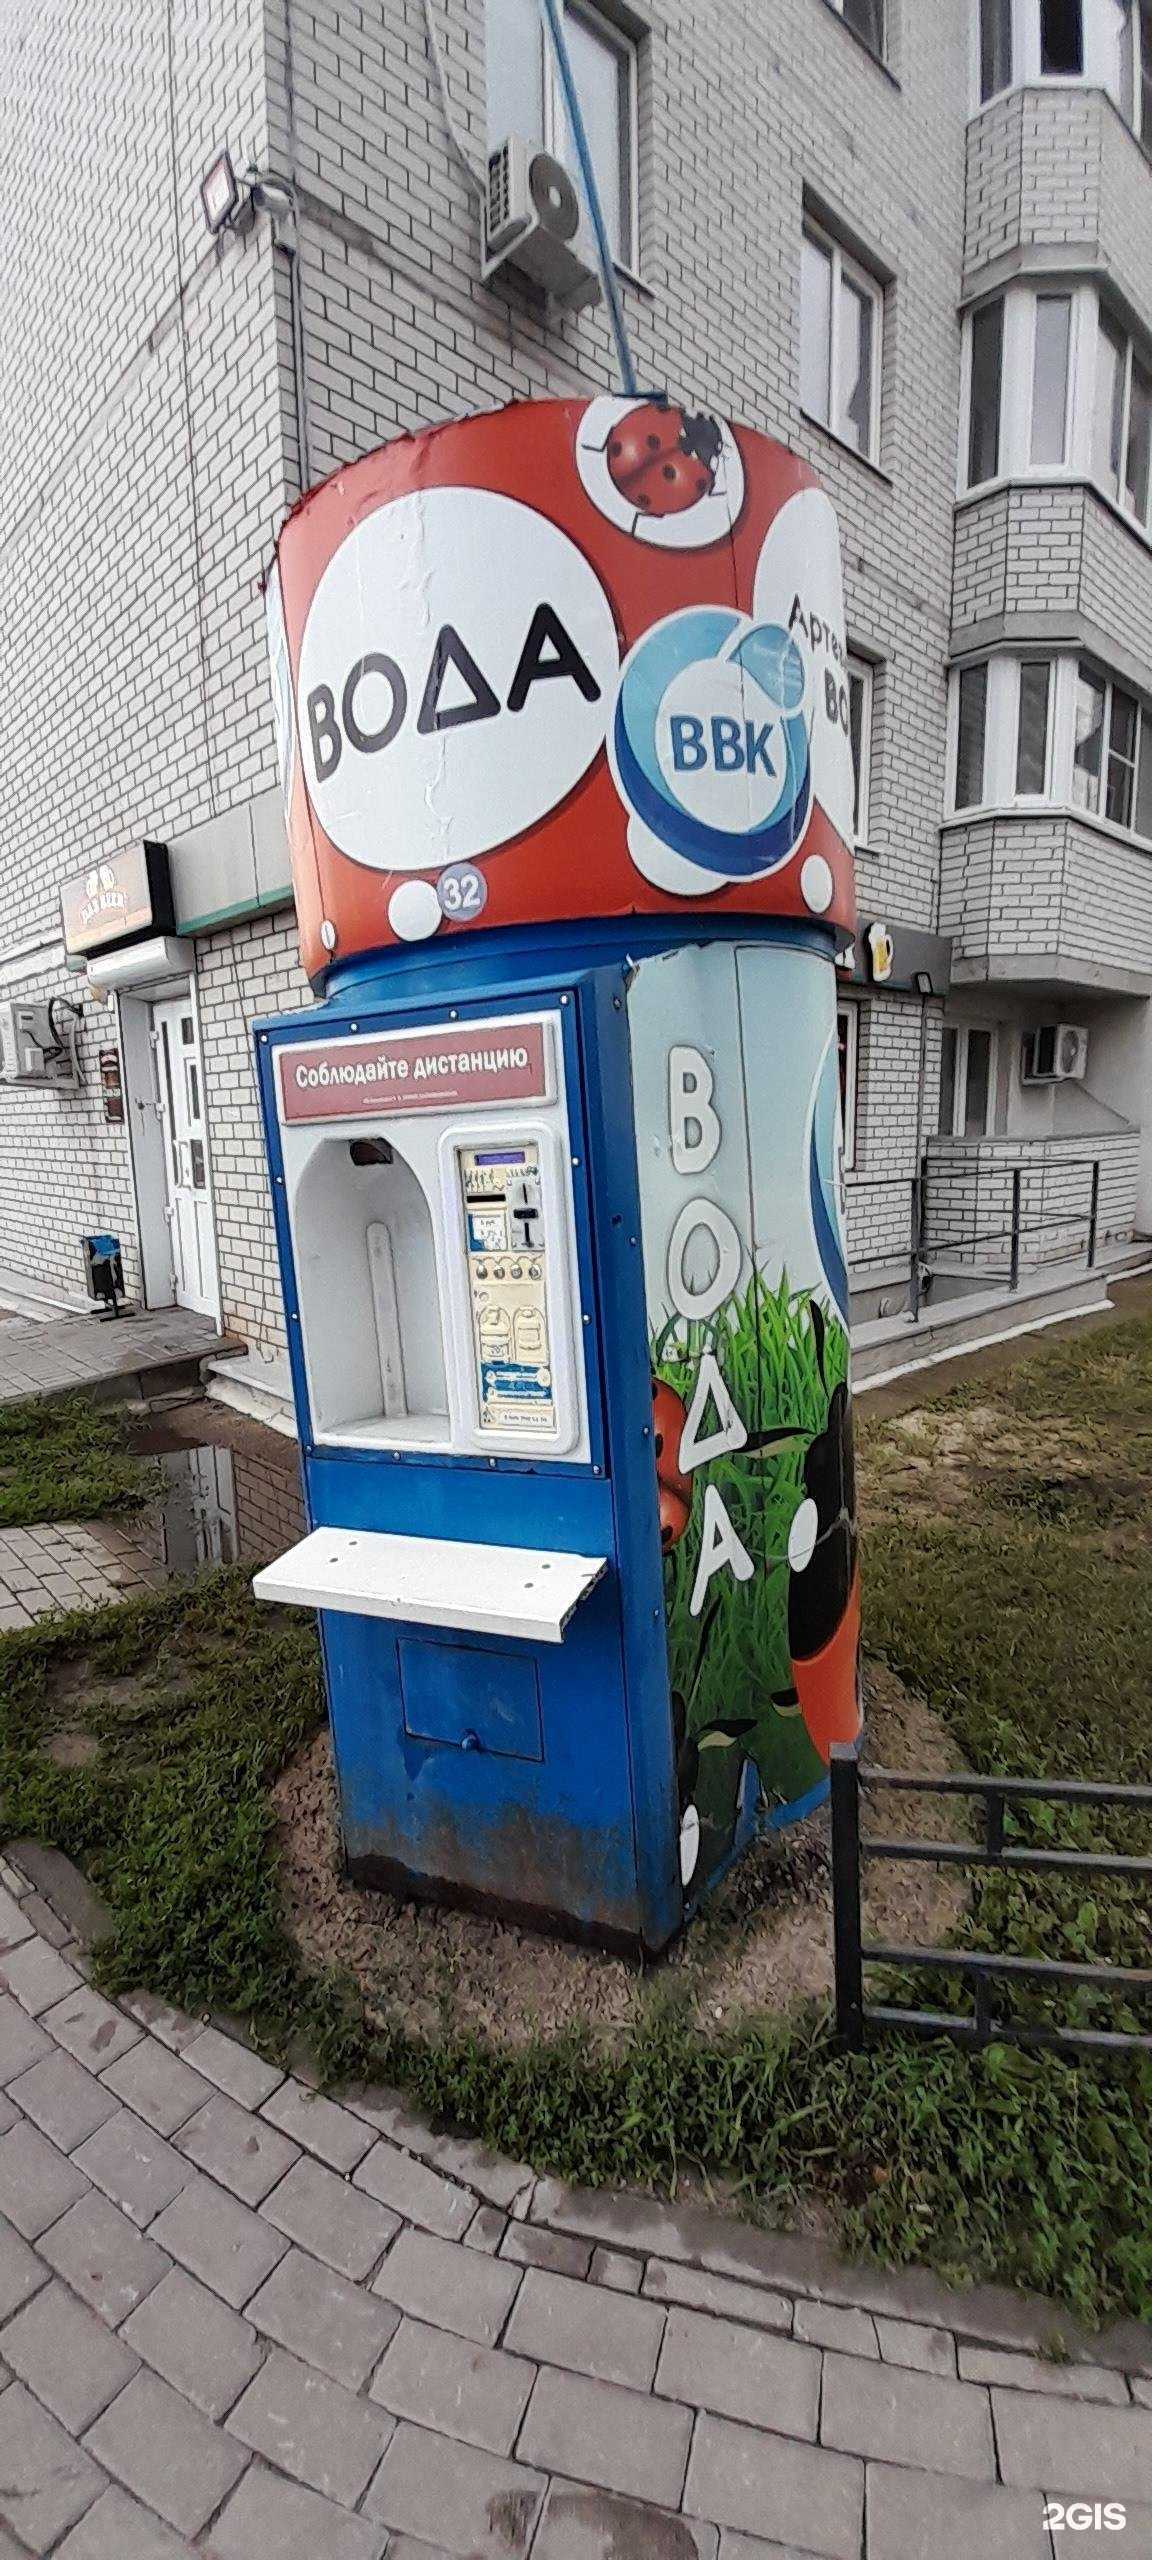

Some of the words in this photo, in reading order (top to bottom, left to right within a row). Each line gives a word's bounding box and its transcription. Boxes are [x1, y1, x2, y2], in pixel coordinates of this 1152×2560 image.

[307, 602, 600, 782] ВОДА
[670, 715, 776, 777] ВВК
[443, 873, 481, 910] 32
[295, 1056, 409, 1088] Соблюдайте
[413, 1047, 528, 1081] дистанцию
[666, 1045, 755, 1617] ВОДА
